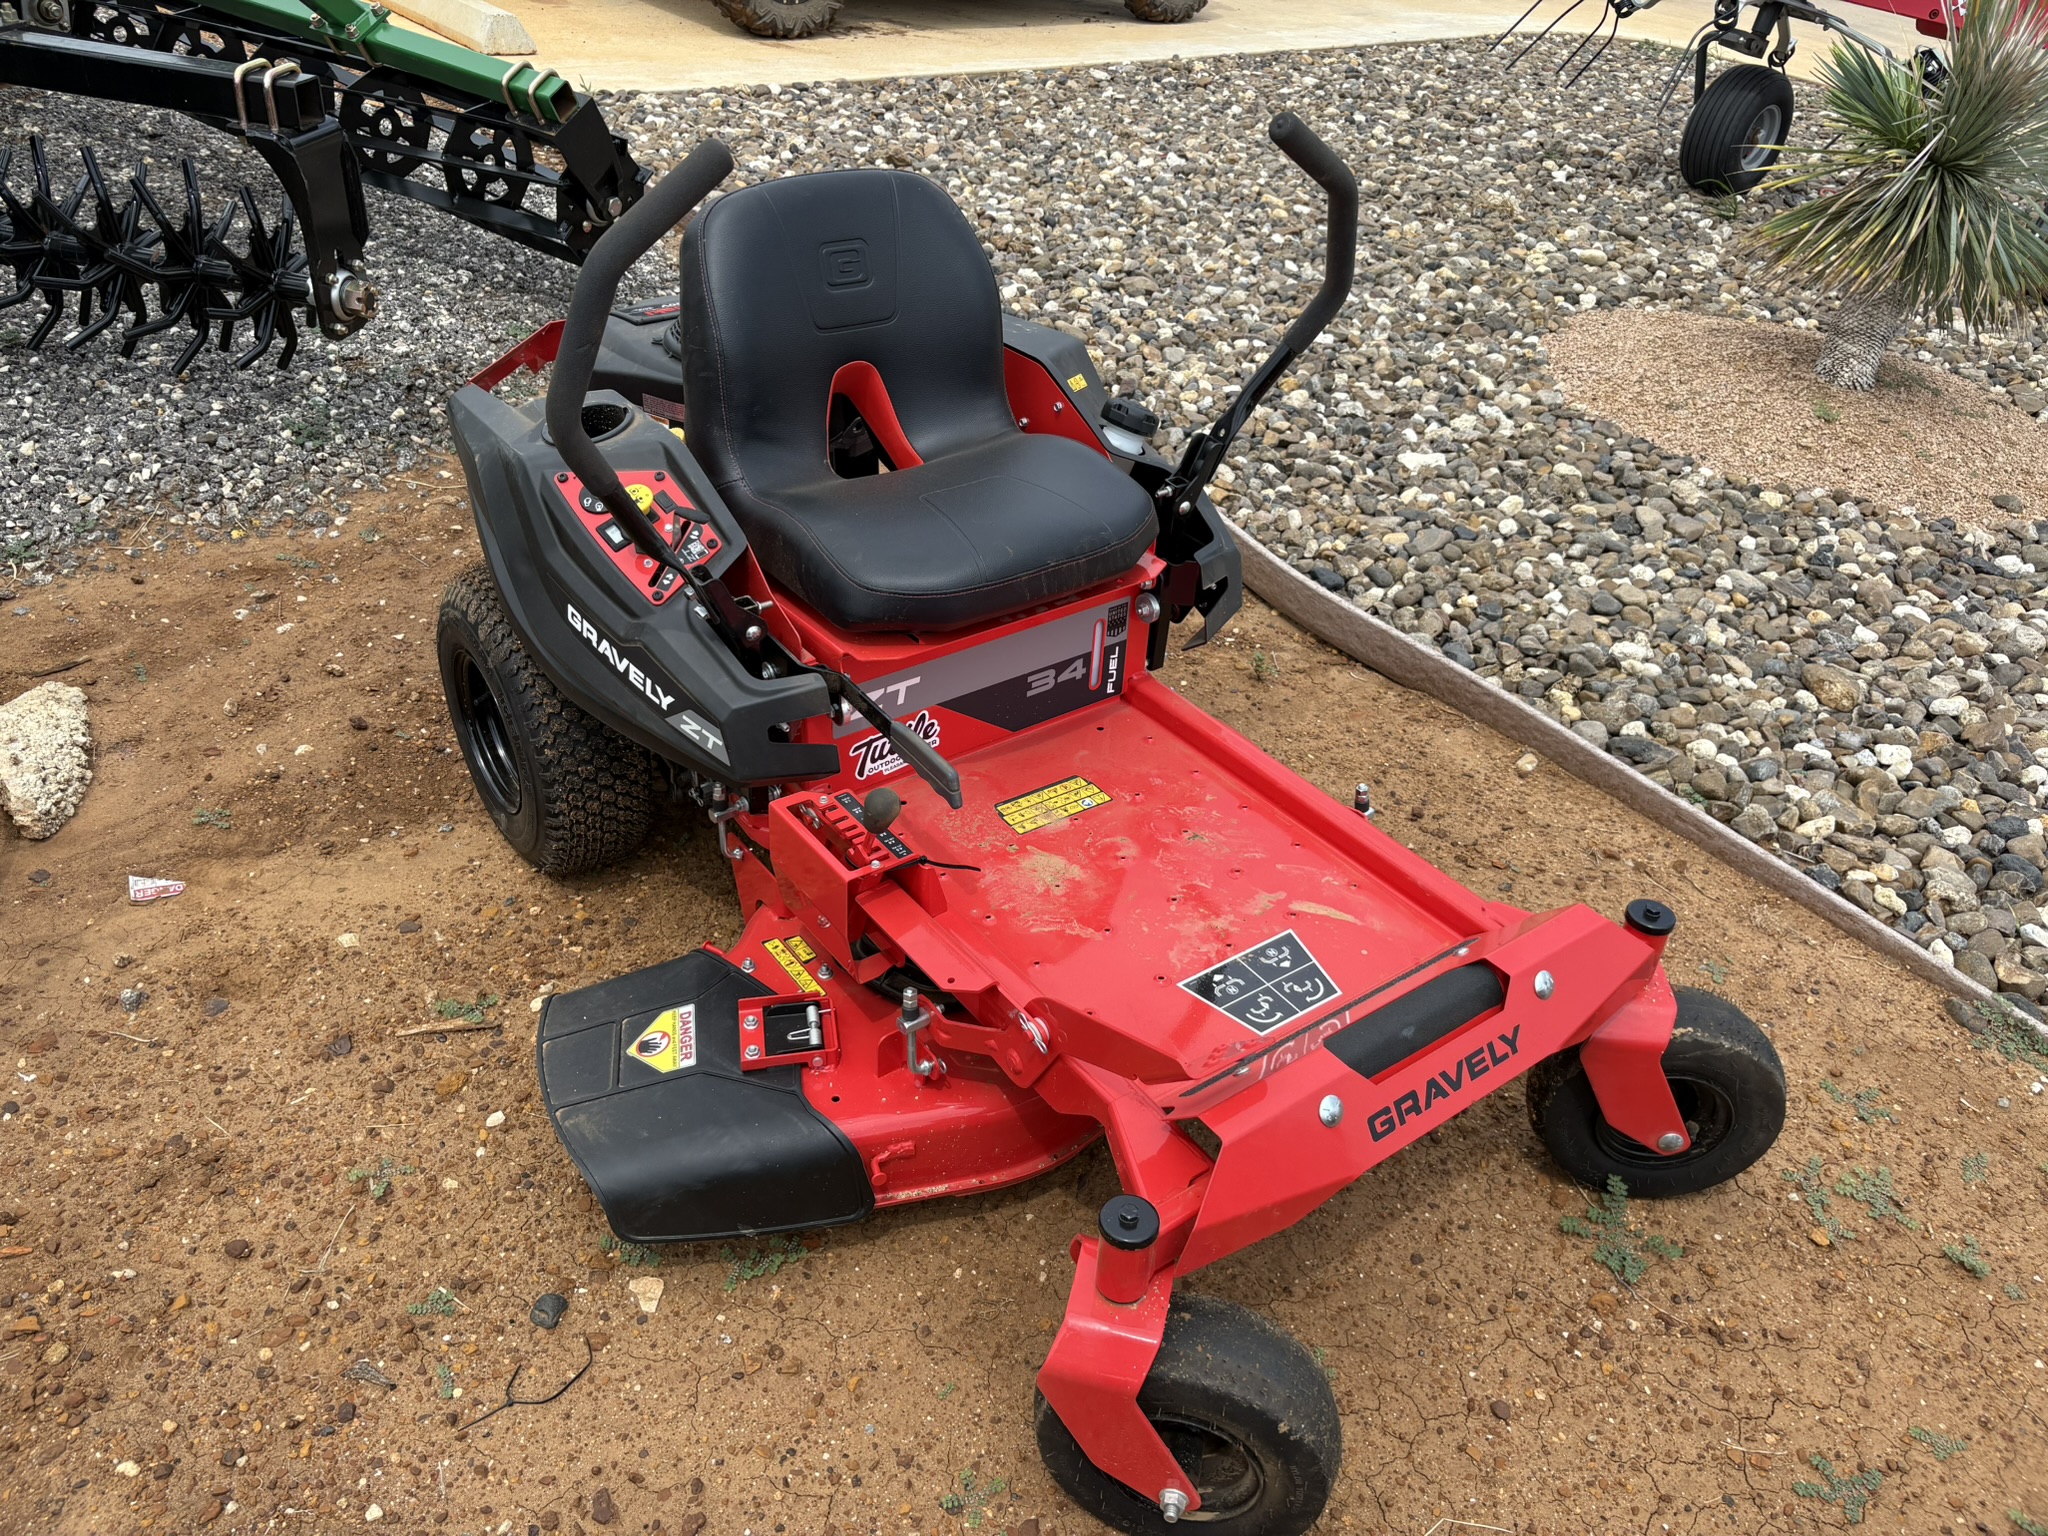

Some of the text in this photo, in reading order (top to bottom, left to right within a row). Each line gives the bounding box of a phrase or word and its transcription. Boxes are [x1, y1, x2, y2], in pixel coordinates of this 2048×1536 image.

[567, 603, 675, 711] GRAVELY
[1026, 658, 1087, 698] 34
[1107, 646, 1119, 693] FUEL
[679, 714, 723, 750] ZT
[851, 712, 938, 779] Tule
[868, 755, 901, 773] OUTDOO
[135, 884, 184, 898] DAGER
[680, 1011, 693, 1062] DANGER
[1367, 1024, 1520, 1142] GRAVELY
